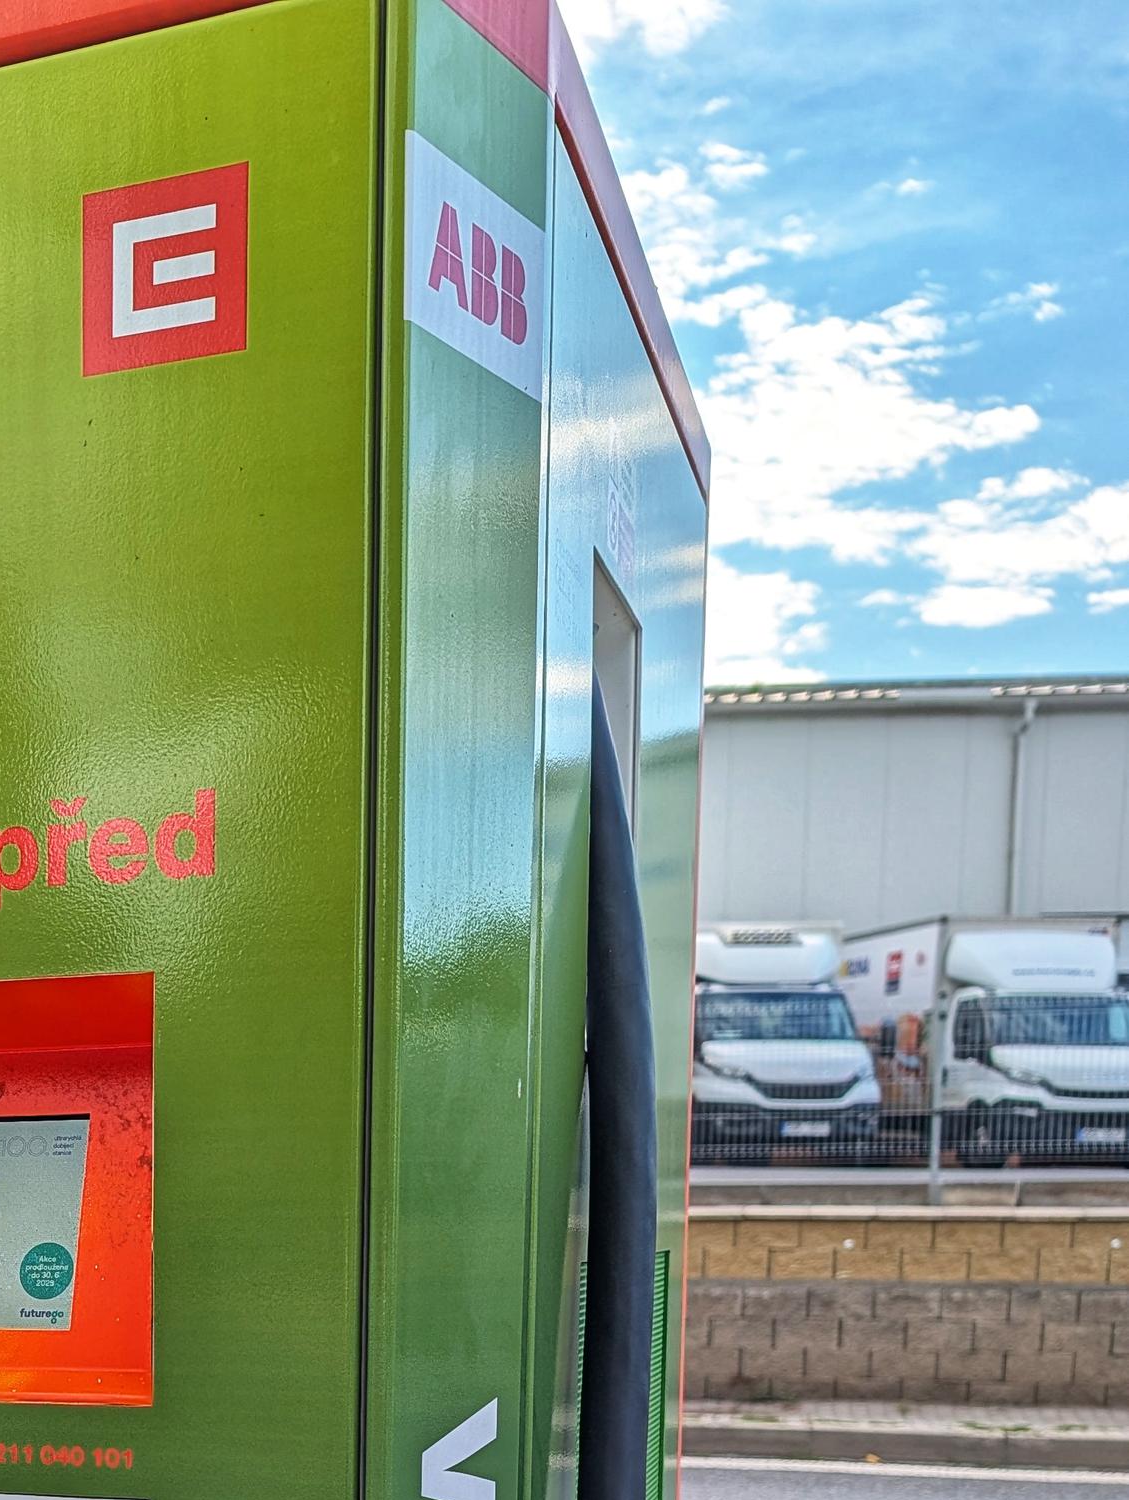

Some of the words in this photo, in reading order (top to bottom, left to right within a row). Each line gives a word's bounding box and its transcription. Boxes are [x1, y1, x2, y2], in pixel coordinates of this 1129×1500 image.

[428, 201, 528, 346] ABB
[20, 1308, 64, 1324] futurego
[40, 1445, 85, 1468] 040
[92, 1448, 133, 1469] 101
